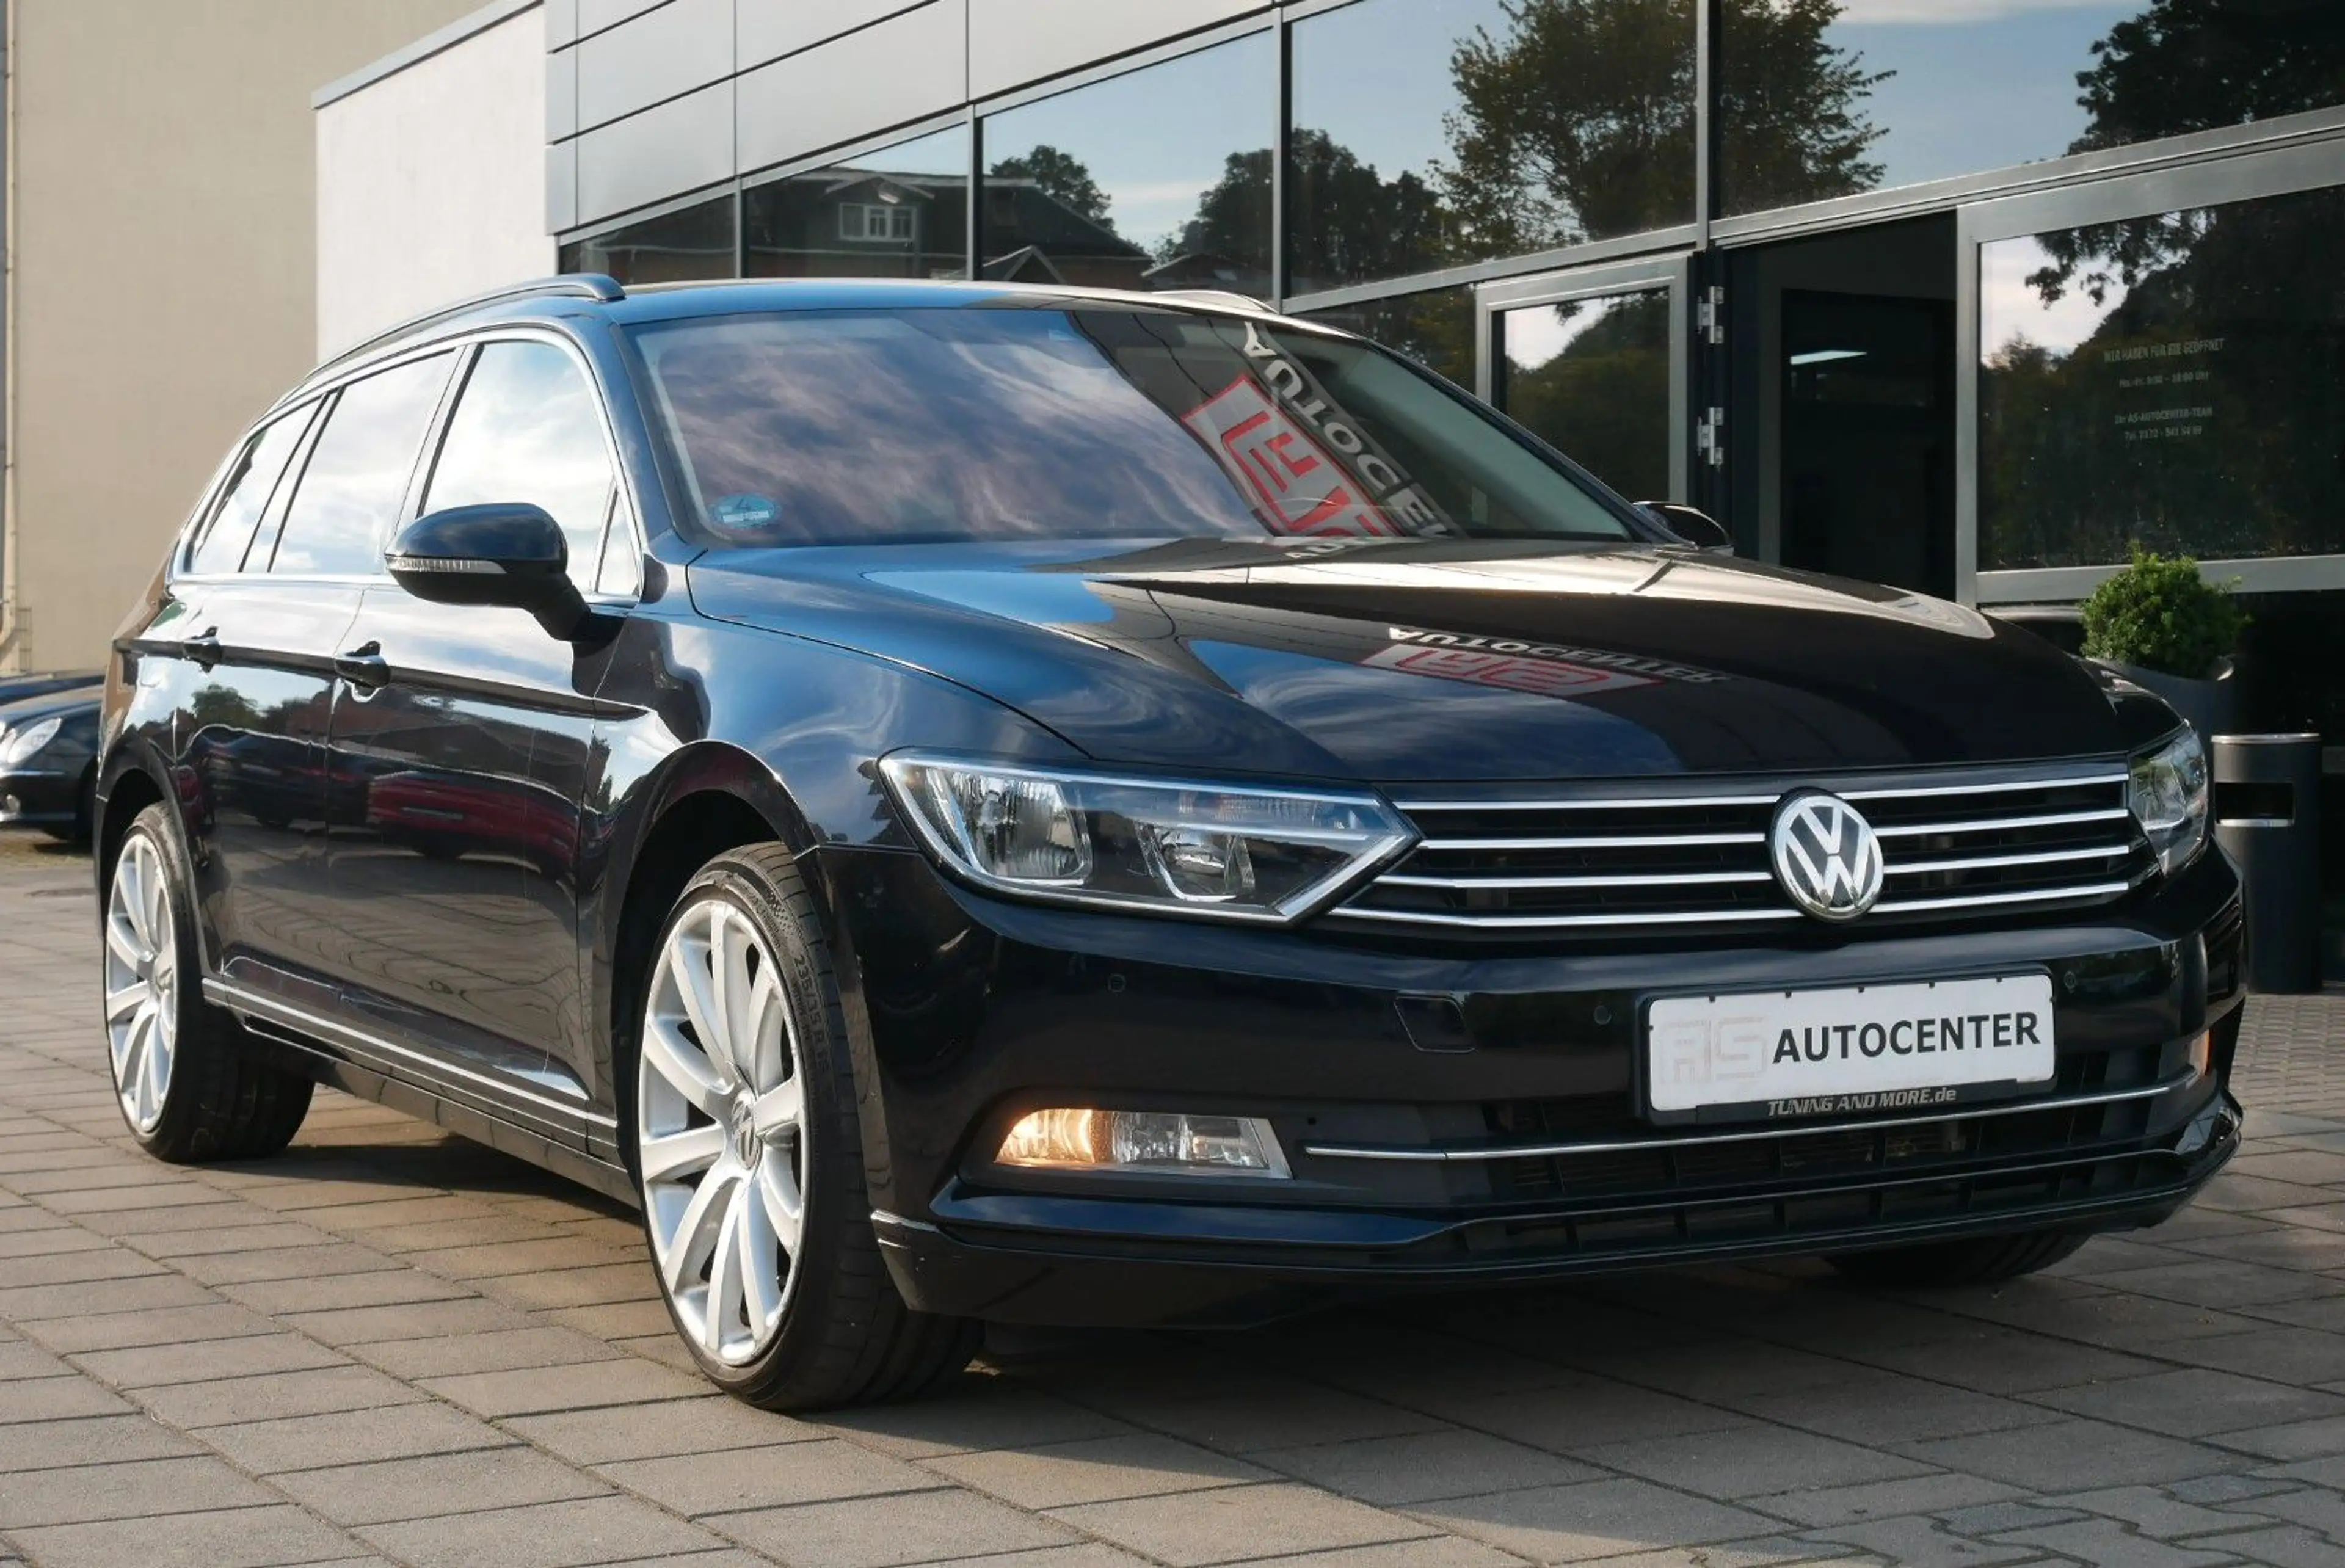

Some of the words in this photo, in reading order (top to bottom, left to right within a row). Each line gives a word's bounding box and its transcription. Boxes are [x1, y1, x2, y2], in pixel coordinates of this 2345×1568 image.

[2183, 337, 2225, 354] GEÖFFNET
[1772, 1011, 2041, 1065] AUTOCENTER
[1767, 1097, 1834, 1117] TUNING
[1836, 1093, 1877, 1111] AND
[1878, 1086, 1957, 1108] MORE.de
